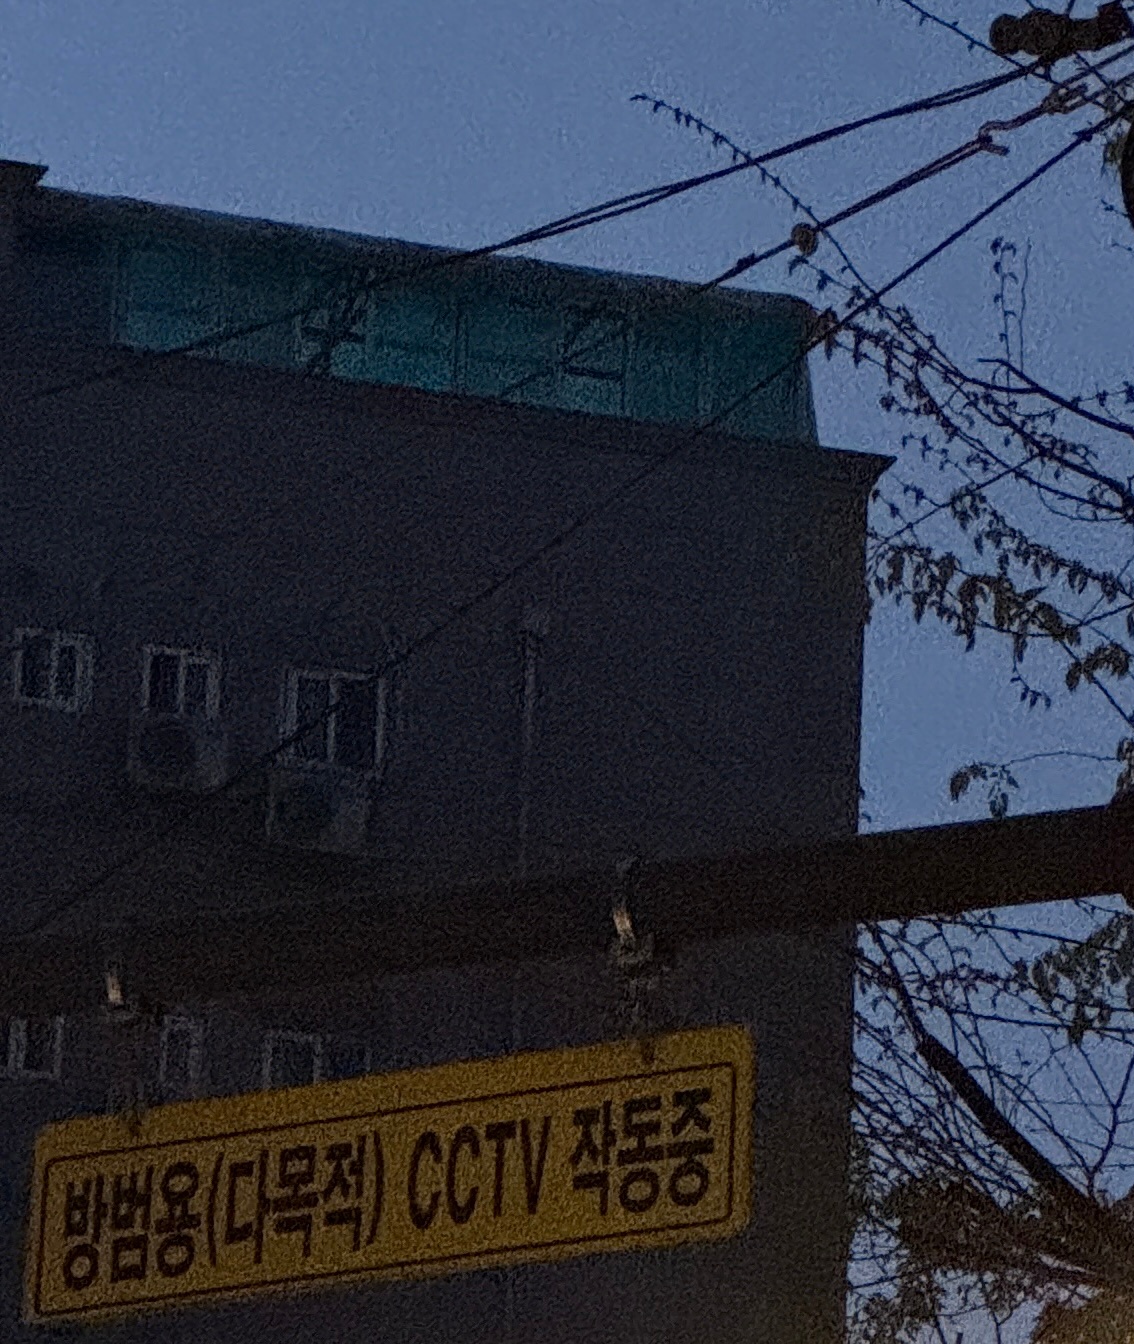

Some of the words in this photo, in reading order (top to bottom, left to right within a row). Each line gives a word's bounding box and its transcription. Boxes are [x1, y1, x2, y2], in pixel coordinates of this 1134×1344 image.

[63, 1130, 385, 1289] 방범용(다목적)
[408, 1117, 553, 1230] CCTV
[572, 1088, 713, 1214] 작동중
